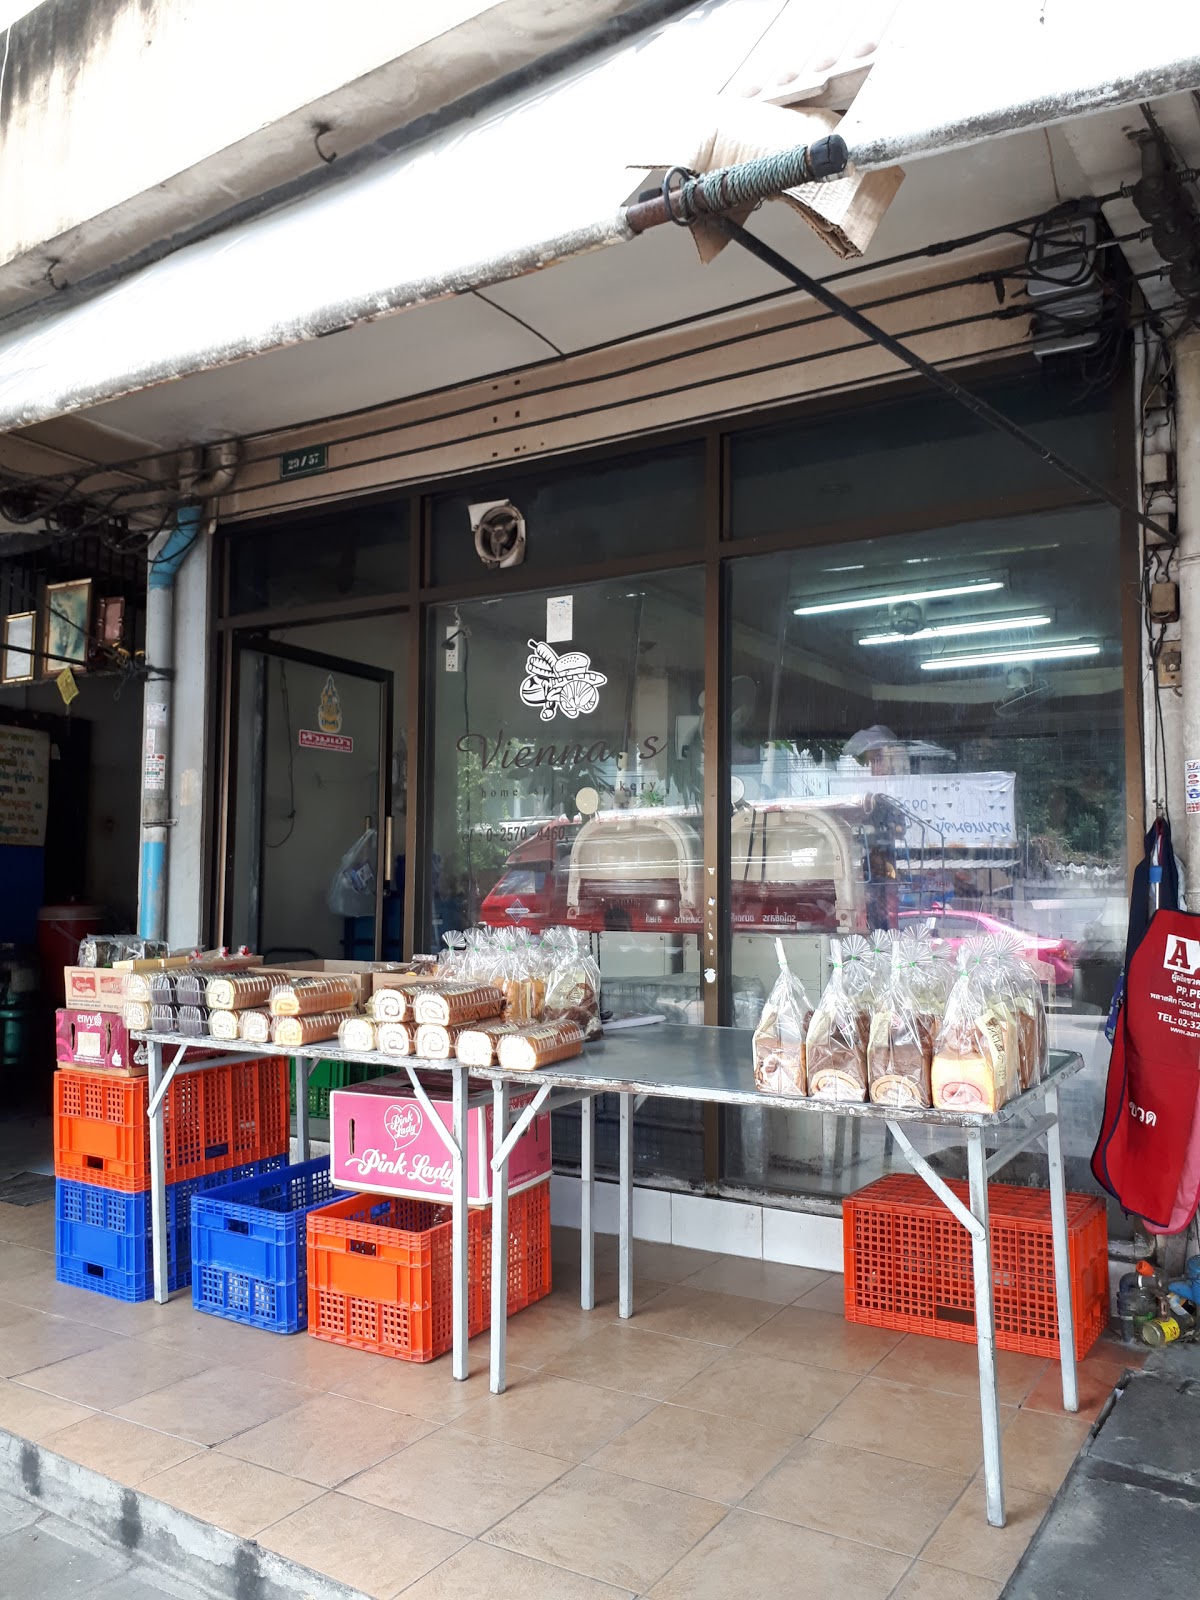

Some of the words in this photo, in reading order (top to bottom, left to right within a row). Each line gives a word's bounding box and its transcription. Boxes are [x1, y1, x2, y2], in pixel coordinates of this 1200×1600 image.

[480, 786, 518, 798] home
[598, 779, 657, 794] bakery
[1177, 998, 1196, 1010] Food
[77, 1013, 94, 1029] envy
[1157, 1011, 1177, 1024] TEL:
[386, 1110, 414, 1131] Pink
[1128, 1101, 1157, 1127] ขวด
[394, 1123, 419, 1139] Lady
[345, 1147, 409, 1176] Pink
[407, 1153, 453, 1189] Lady
